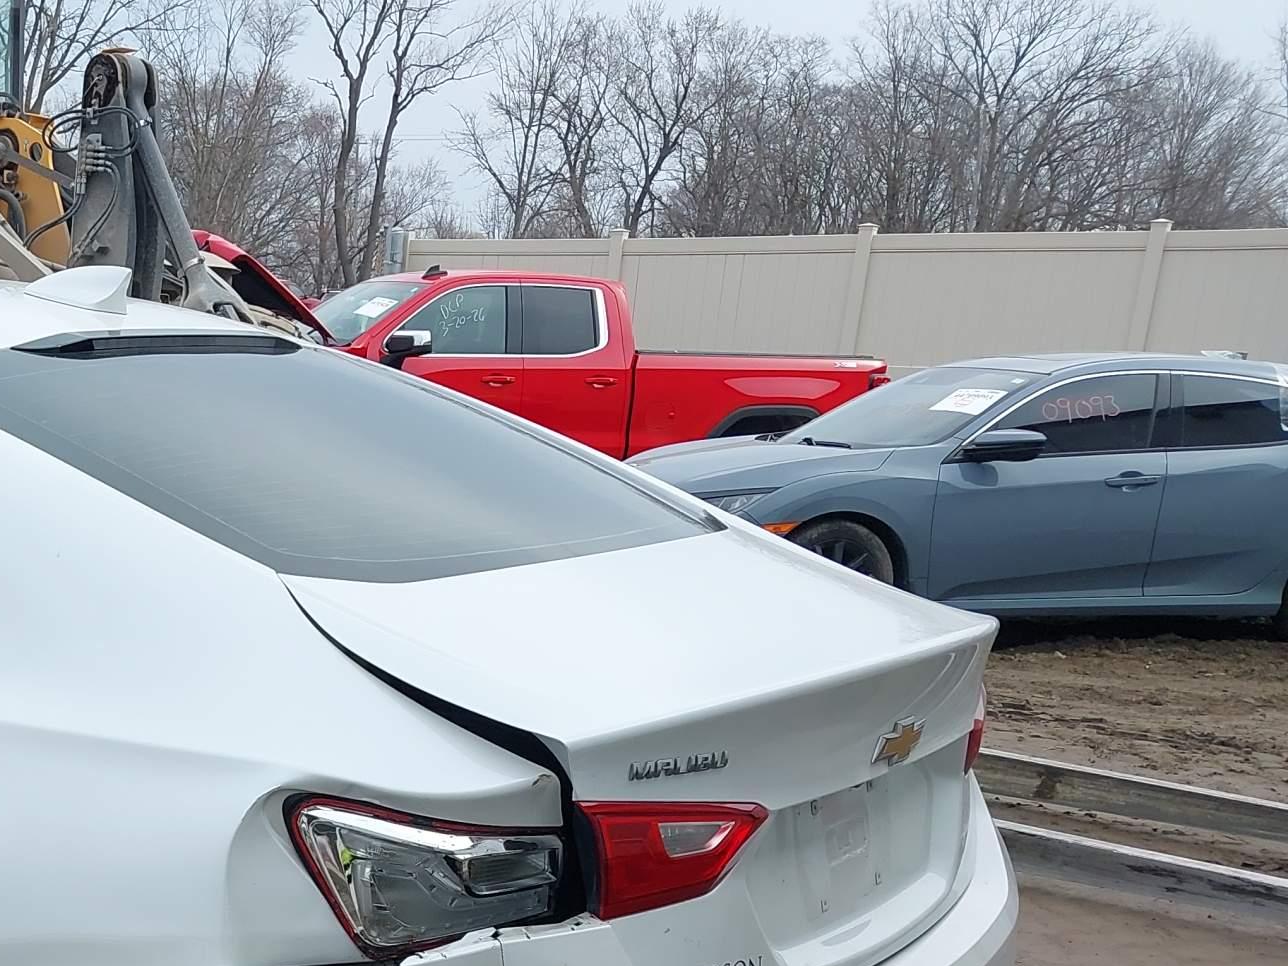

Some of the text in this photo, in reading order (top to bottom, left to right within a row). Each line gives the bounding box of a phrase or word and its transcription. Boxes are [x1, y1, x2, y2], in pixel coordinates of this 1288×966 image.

[439, 307, 485, 337] 3-20-26
[1042, 395, 1121, 424] 09093
[628, 749, 729, 782] MALIBU
